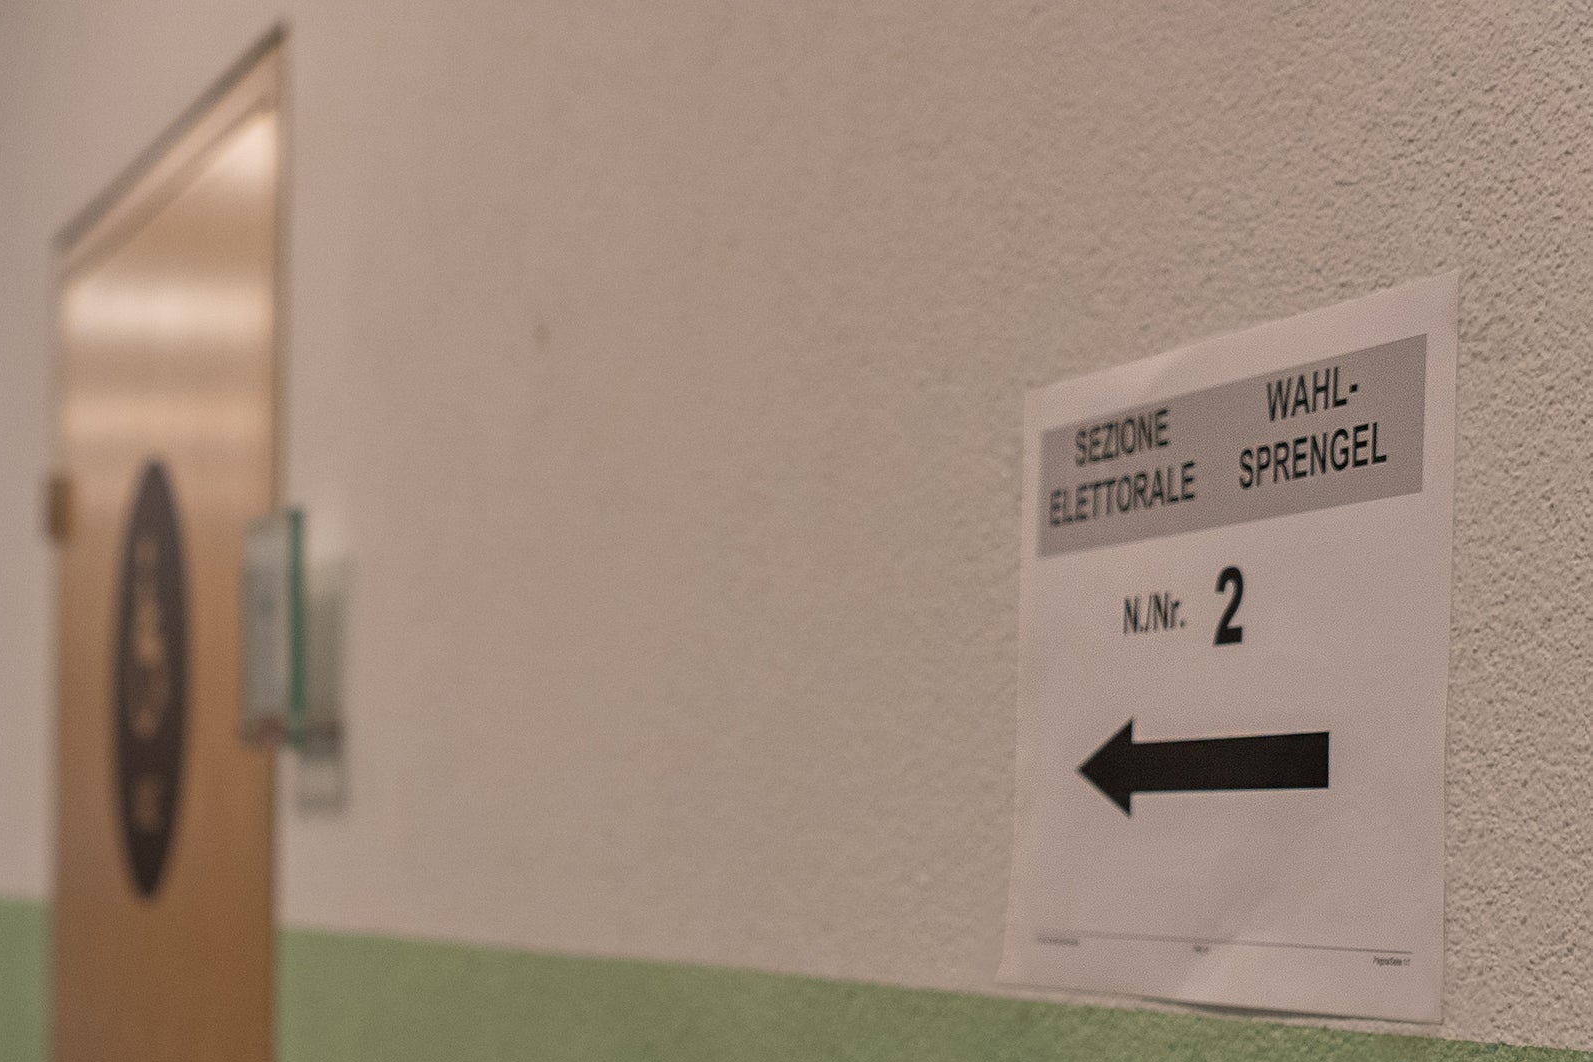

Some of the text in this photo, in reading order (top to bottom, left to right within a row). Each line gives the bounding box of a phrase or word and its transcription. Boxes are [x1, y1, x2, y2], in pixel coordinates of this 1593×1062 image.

[1266, 366, 1359, 421] WAHL-
[1074, 409, 1170, 467] SEZIONE
[1238, 422, 1388, 489] SPRENGEL
[1048, 461, 1196, 527] ELETTORALE
[1123, 566, 1243, 645] N./Nr. 2
